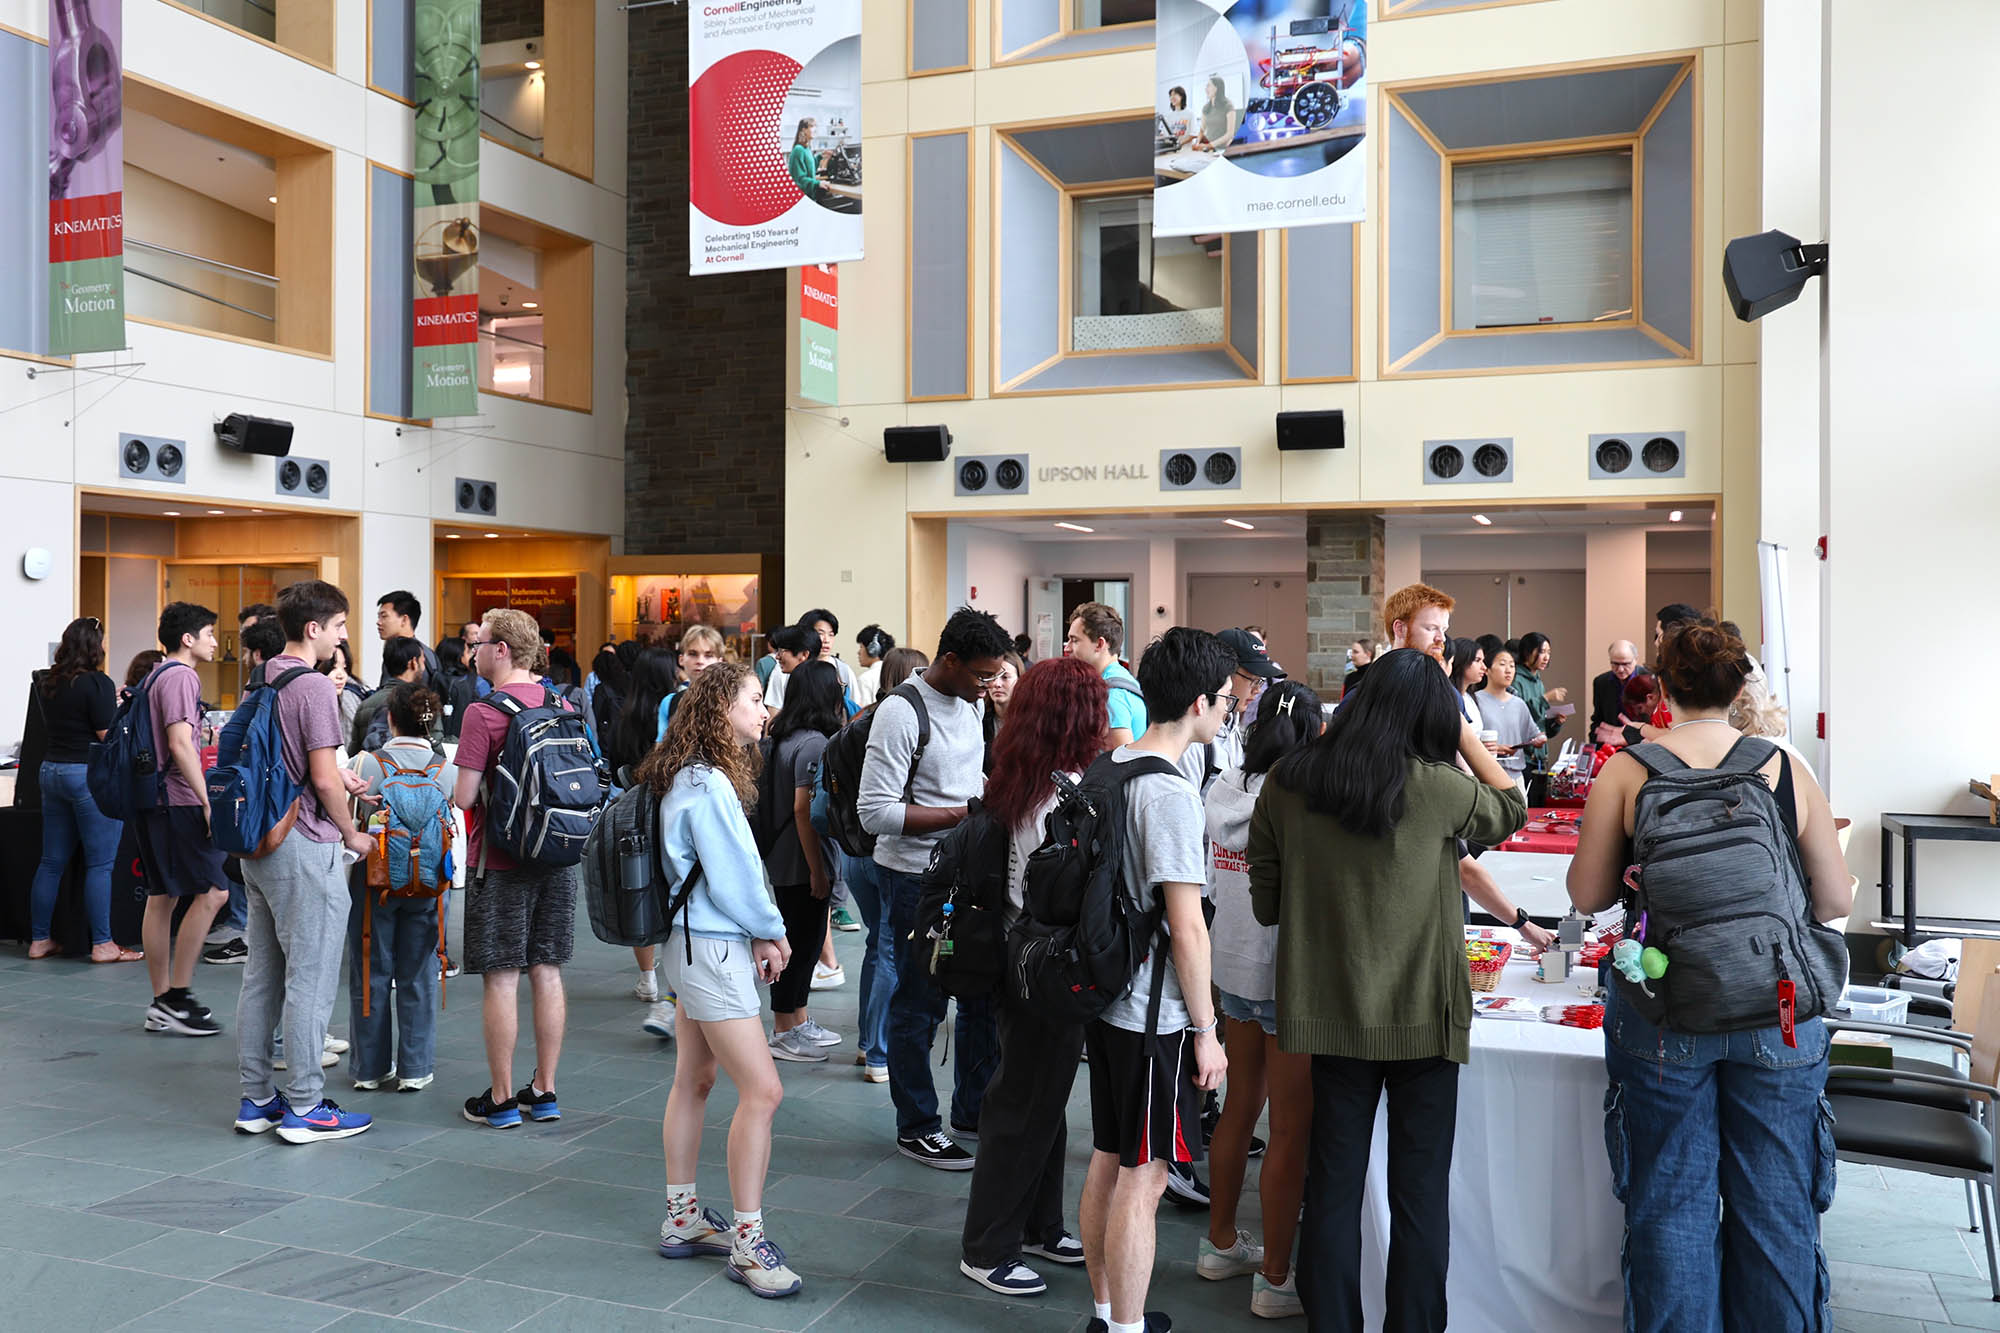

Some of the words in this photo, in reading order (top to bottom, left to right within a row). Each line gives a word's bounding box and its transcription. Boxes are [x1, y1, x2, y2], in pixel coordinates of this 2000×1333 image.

[703, 19, 727, 29] Sibley
[728, 13, 757, 25] School
[759, 12, 767, 21] of
[769, 4, 815, 19] Mechanical
[703, 30, 719, 39] and
[720, 24, 763, 36] Aerospace
[765, 16, 813, 31] Engineering
[1247, 194, 1346, 212] mae.cornell.edu
[54, 215, 122, 236] KINEMATICS
[705, 232, 751, 243] Celebrating
[752, 229, 767, 238] 150
[767, 228, 789, 237] Years
[790, 226, 799, 234] of
[705, 242, 749, 253] Mechanical
[751, 238, 799, 249] Engineering
[715, 253, 745, 263] Cornell
[71, 283, 112, 296] Geometry
[64, 296, 116, 314] Motion
[416, 311, 478, 327] KINEMATICS
[426, 373, 469, 388] Motion
[1039, 465, 1097, 482] UPSON
[1103, 464, 1149, 480] HALL
